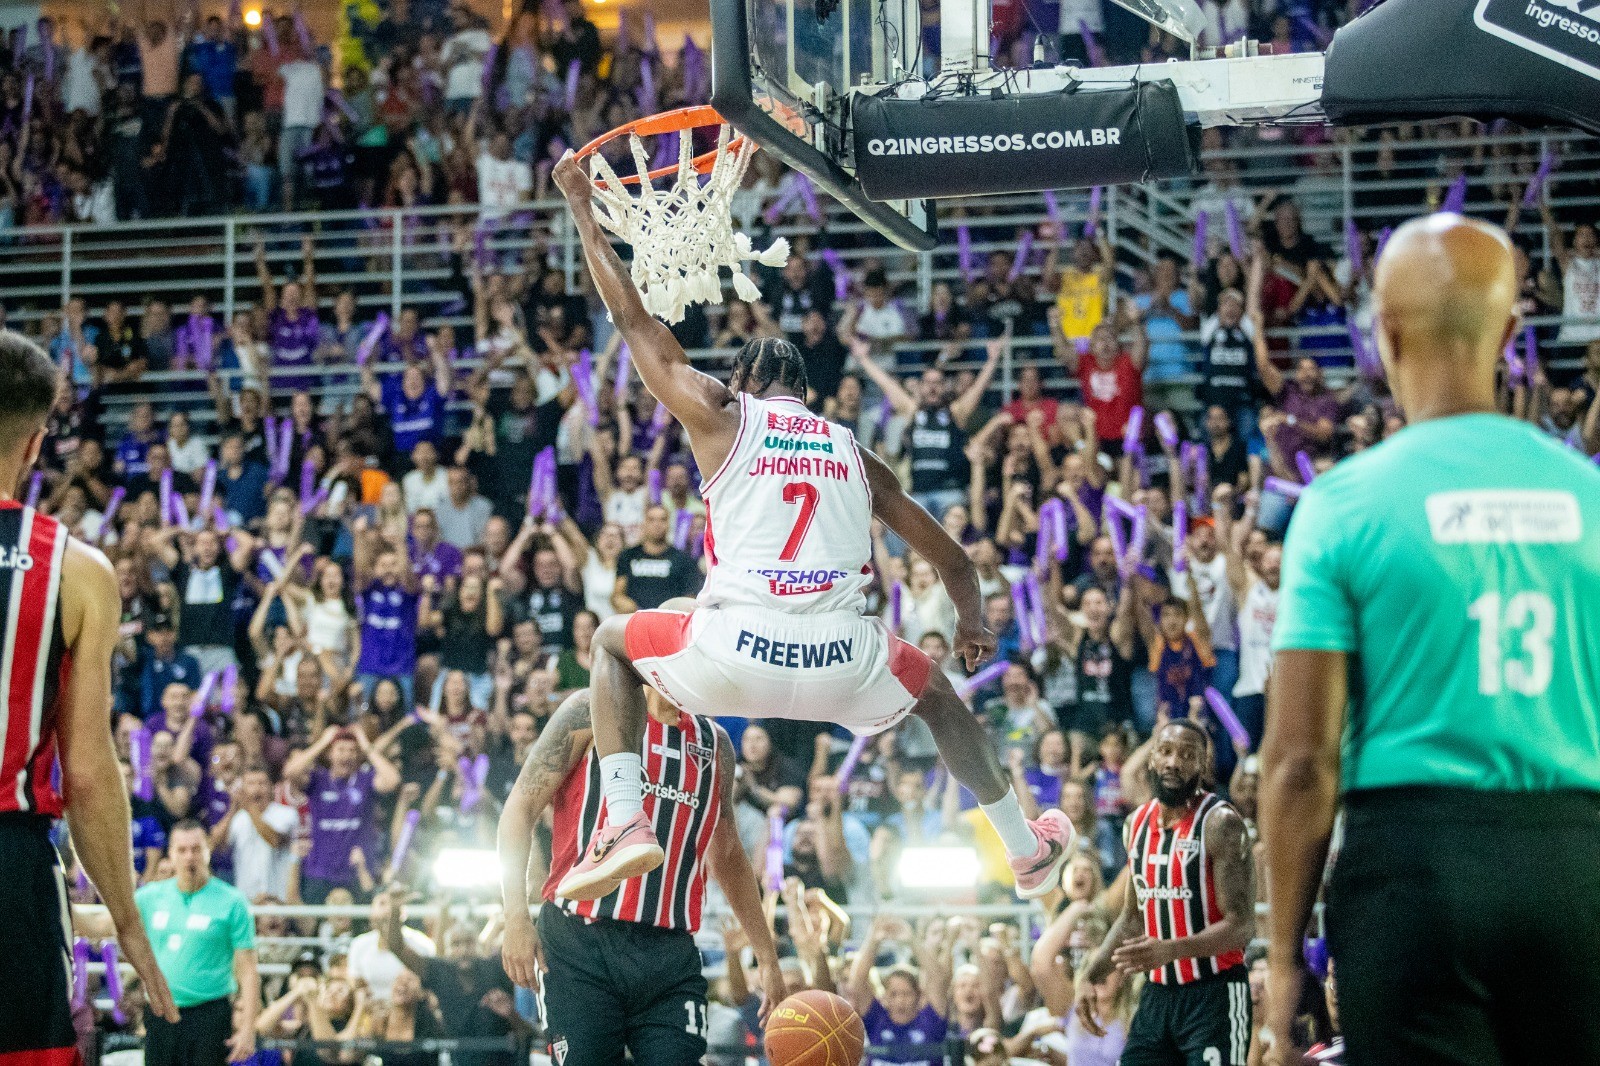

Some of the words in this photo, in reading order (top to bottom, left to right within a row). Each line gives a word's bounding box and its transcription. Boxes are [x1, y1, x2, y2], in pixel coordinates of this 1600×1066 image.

[867, 127, 1122, 156] Q2INGRESSOS.COM.BR
[764, 435, 834, 454] Unimed
[749, 456, 849, 482] JHONATAN
[778, 481, 821, 562] 7
[735, 629, 854, 669] FREEWAY
[1466, 590, 1558, 697] 13
[684, 1000, 707, 1040] 11
[769, 1008, 810, 1025] PEN
